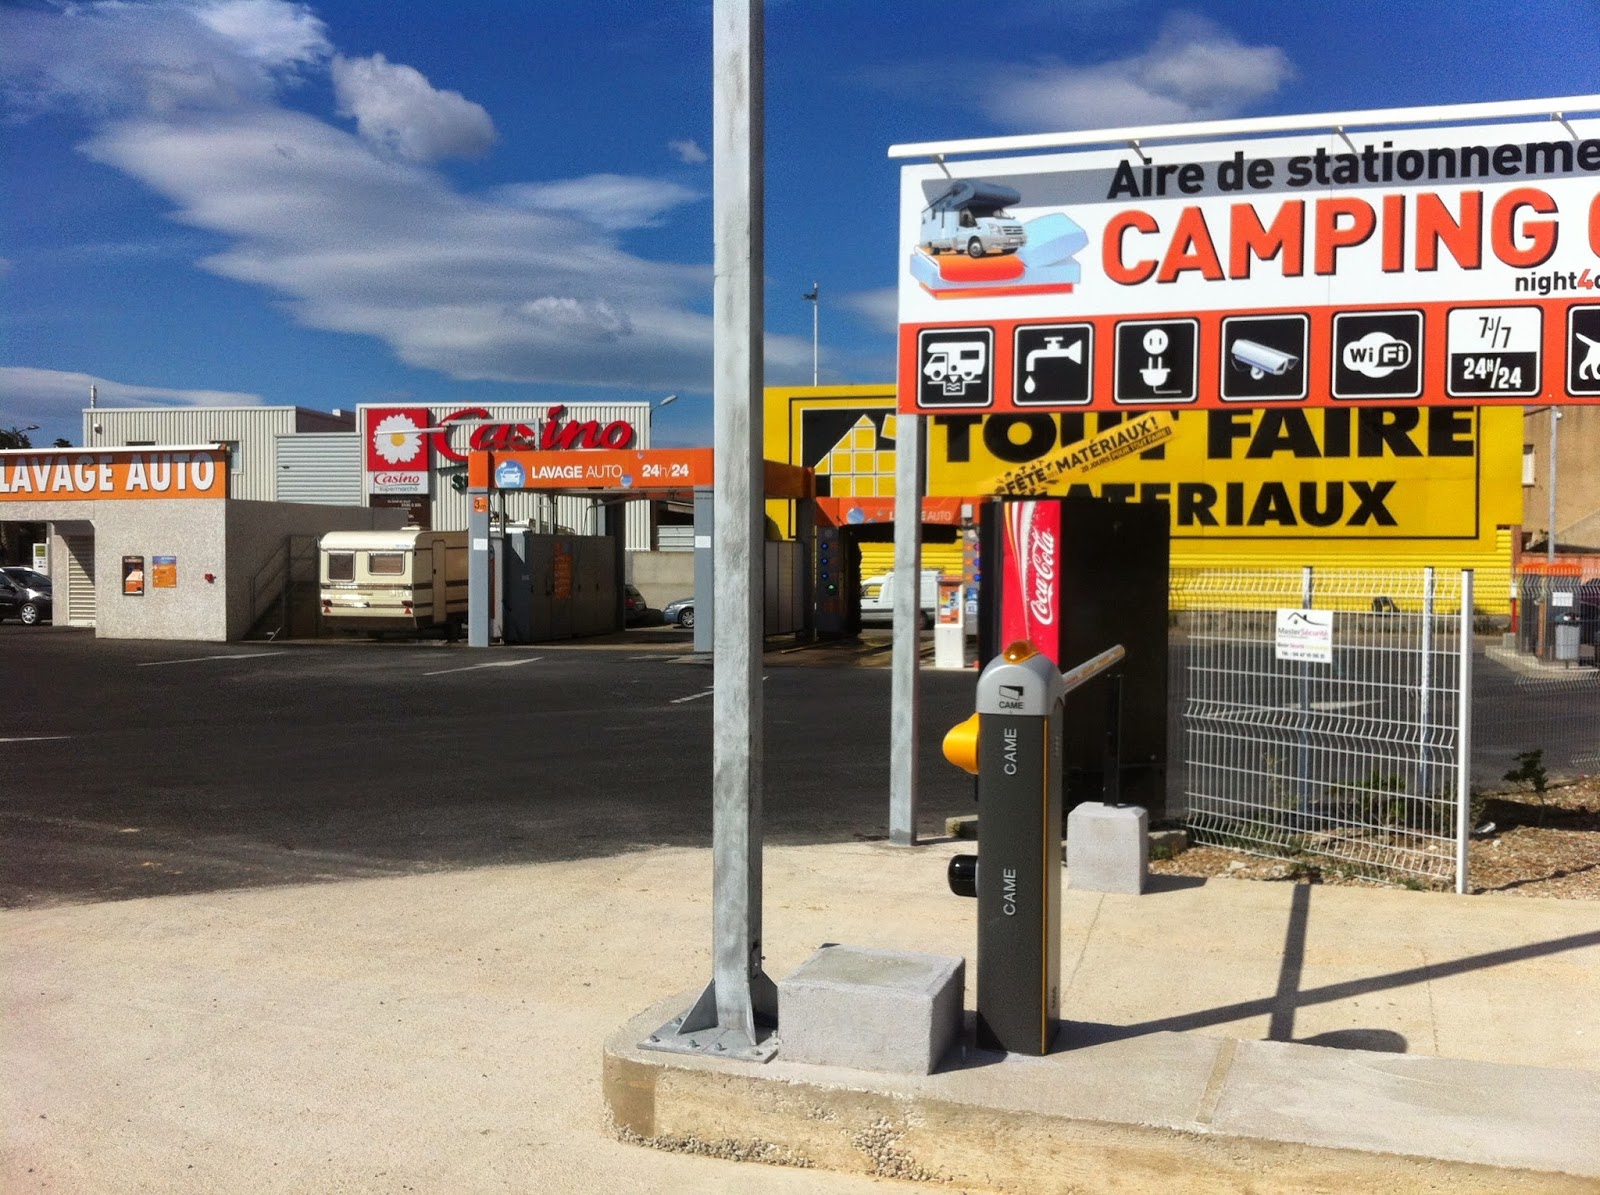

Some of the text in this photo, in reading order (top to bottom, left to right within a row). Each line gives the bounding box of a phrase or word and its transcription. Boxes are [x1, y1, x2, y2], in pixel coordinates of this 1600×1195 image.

[1107, 137, 1600, 199] Aire de stationneme
[1102, 187, 1558, 286] CAMPING
[432, 405, 633, 462] Casino
[1055, 418, 1151, 474] MATÉRIAUX
[1207, 406, 1474, 459] FAIRE
[0, 448, 215, 493] LAVAGE AUTO
[374, 472, 420, 486] Casino
[532, 463, 689, 479] LAVAGE AUTO 24h/24
[927, 511, 952, 521] AUTO
[999, 701, 1024, 710] CAME
[1003, 727, 1018, 776] CAME
[1002, 866, 1017, 917] CAME
